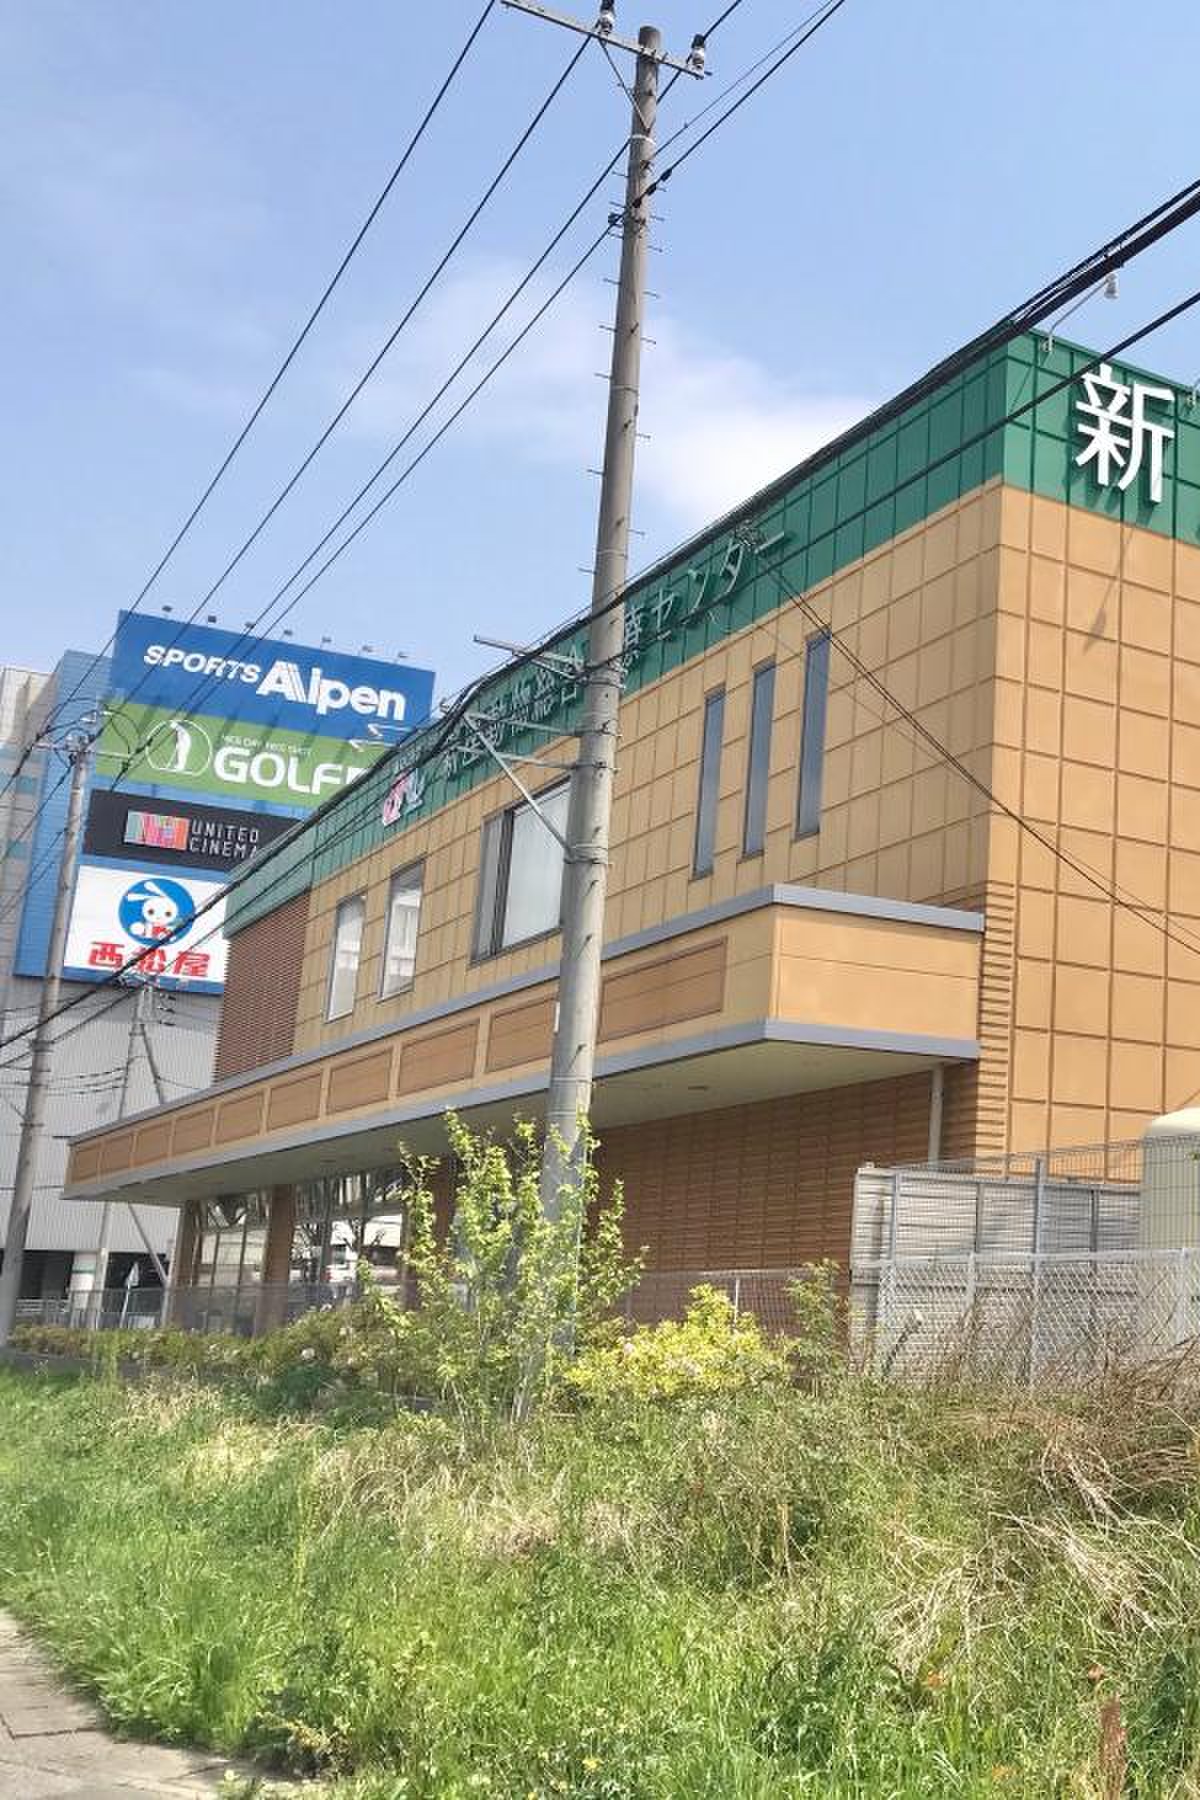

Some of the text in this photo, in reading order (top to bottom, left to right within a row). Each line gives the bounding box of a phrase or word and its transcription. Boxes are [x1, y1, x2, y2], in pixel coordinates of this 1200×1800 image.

[143, 645, 407, 721] SPORTS Alpen
[191, 819, 259, 844] UNITED
